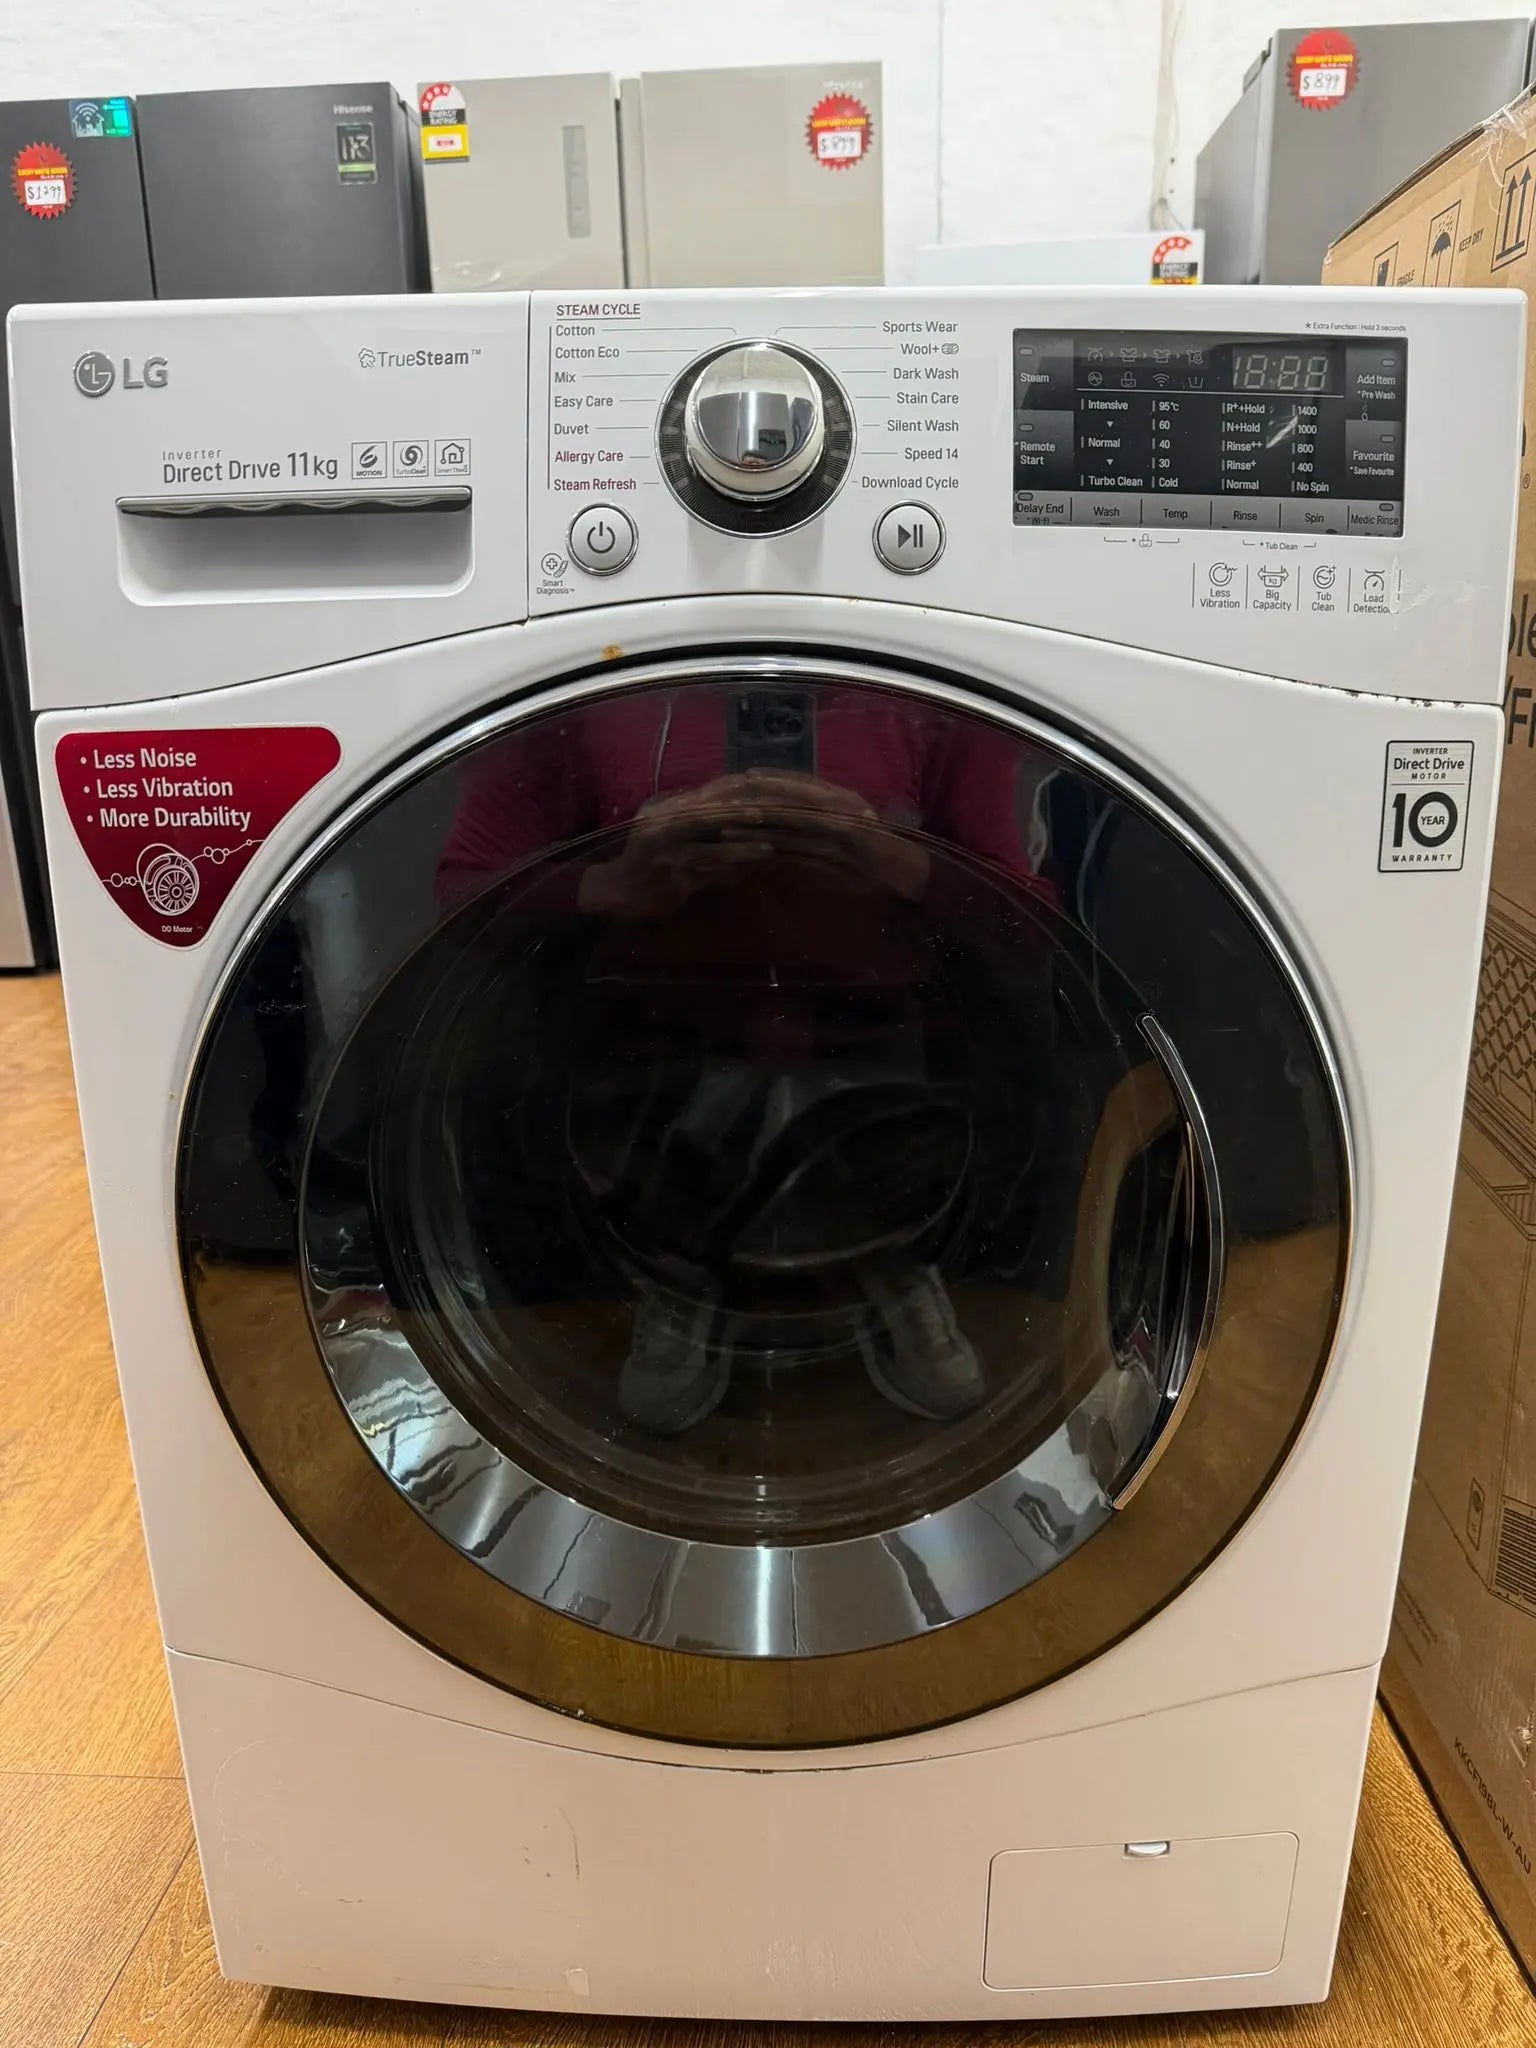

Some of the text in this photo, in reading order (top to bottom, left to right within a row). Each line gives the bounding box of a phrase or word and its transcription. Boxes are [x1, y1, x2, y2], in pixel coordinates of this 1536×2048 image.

[556, 303, 641, 316] STEAM CYCLE
[555, 325, 596, 336] Cotton
[882, 320, 958, 335] Sports Wear
[1313, 322, 1329, 330] Extra
[1331, 323, 1357, 331] Function
[555, 347, 620, 359] Cotton Eco
[123, 356, 169, 389] LG
[554, 372, 576, 384] Mix
[893, 367, 959, 380] Dark Wash
[1020, 373, 1050, 383] Steam
[1356, 374, 1396, 385] Add Item
[896, 392, 959, 404] Stain Care
[1361, 390, 1396, 400] Pre Wash
[554, 395, 614, 410] Easy Care
[1088, 400, 1129, 411] Intensive
[1298, 406, 1317, 416] 1400
[554, 423, 589, 435] Duvet
[887, 419, 959, 432] Silent Wash
[1159, 420, 1170, 430] 60
[1227, 423, 1261, 433] N+Hold
[1298, 425, 1317, 435] 1000
[1020, 441, 1056, 452] Remote
[1088, 438, 1121, 448] Normal
[1159, 439, 1170, 449] 40
[1297, 444, 1314, 453] 800
[162, 449, 222, 461] Inverter
[555, 450, 624, 464] Allergy Care
[904, 447, 959, 462] Speed 14
[1353, 451, 1395, 463] Favourite
[1020, 455, 1044, 466] Start
[1159, 458, 1170, 468] 30
[163, 463, 223, 484] Direct
[228, 460, 281, 481] Drive
[1297, 462, 1313, 472] 400
[1353, 466, 1394, 477] Save Favourite
[554, 478, 637, 491] Steam Refresh
[861, 476, 959, 491] Download Cycle
[1088, 476, 1143, 487] Turbo Clean
[1158, 477, 1178, 488] Cold
[1226, 479, 1260, 490] Normal
[1296, 482, 1329, 494] No Spin
[1016, 503, 1064, 515] Delay End
[1093, 506, 1120, 517] Wash
[1233, 510, 1257, 521] Rinse
[1304, 513, 1325, 524] Spin
[1351, 514, 1399, 526] Medic Rinse
[1265, 542, 1298, 550] Tub Clean
[542, 579, 563, 587] Smart
[1210, 588, 1231, 598] Less
[1265, 590, 1280, 601] Big
[1316, 592, 1332, 601] Tub
[1363, 594, 1384, 603] Load
[1199, 598, 1240, 609] Vibration
[1253, 600, 1292, 611] Capacity
[1312, 601, 1335, 612] Clean
[93, 747, 197, 770] Less Noise
[1393, 758, 1465, 770] Direct Drive
[97, 776, 233, 799] Less Vibration
[100, 806, 251, 832] More Durability
[1392, 791, 1459, 848] 10
[1420, 816, 1446, 826] YEAR
[1392, 854, 1453, 862] WARRANTY
[161, 925, 193, 933] DD Motor
